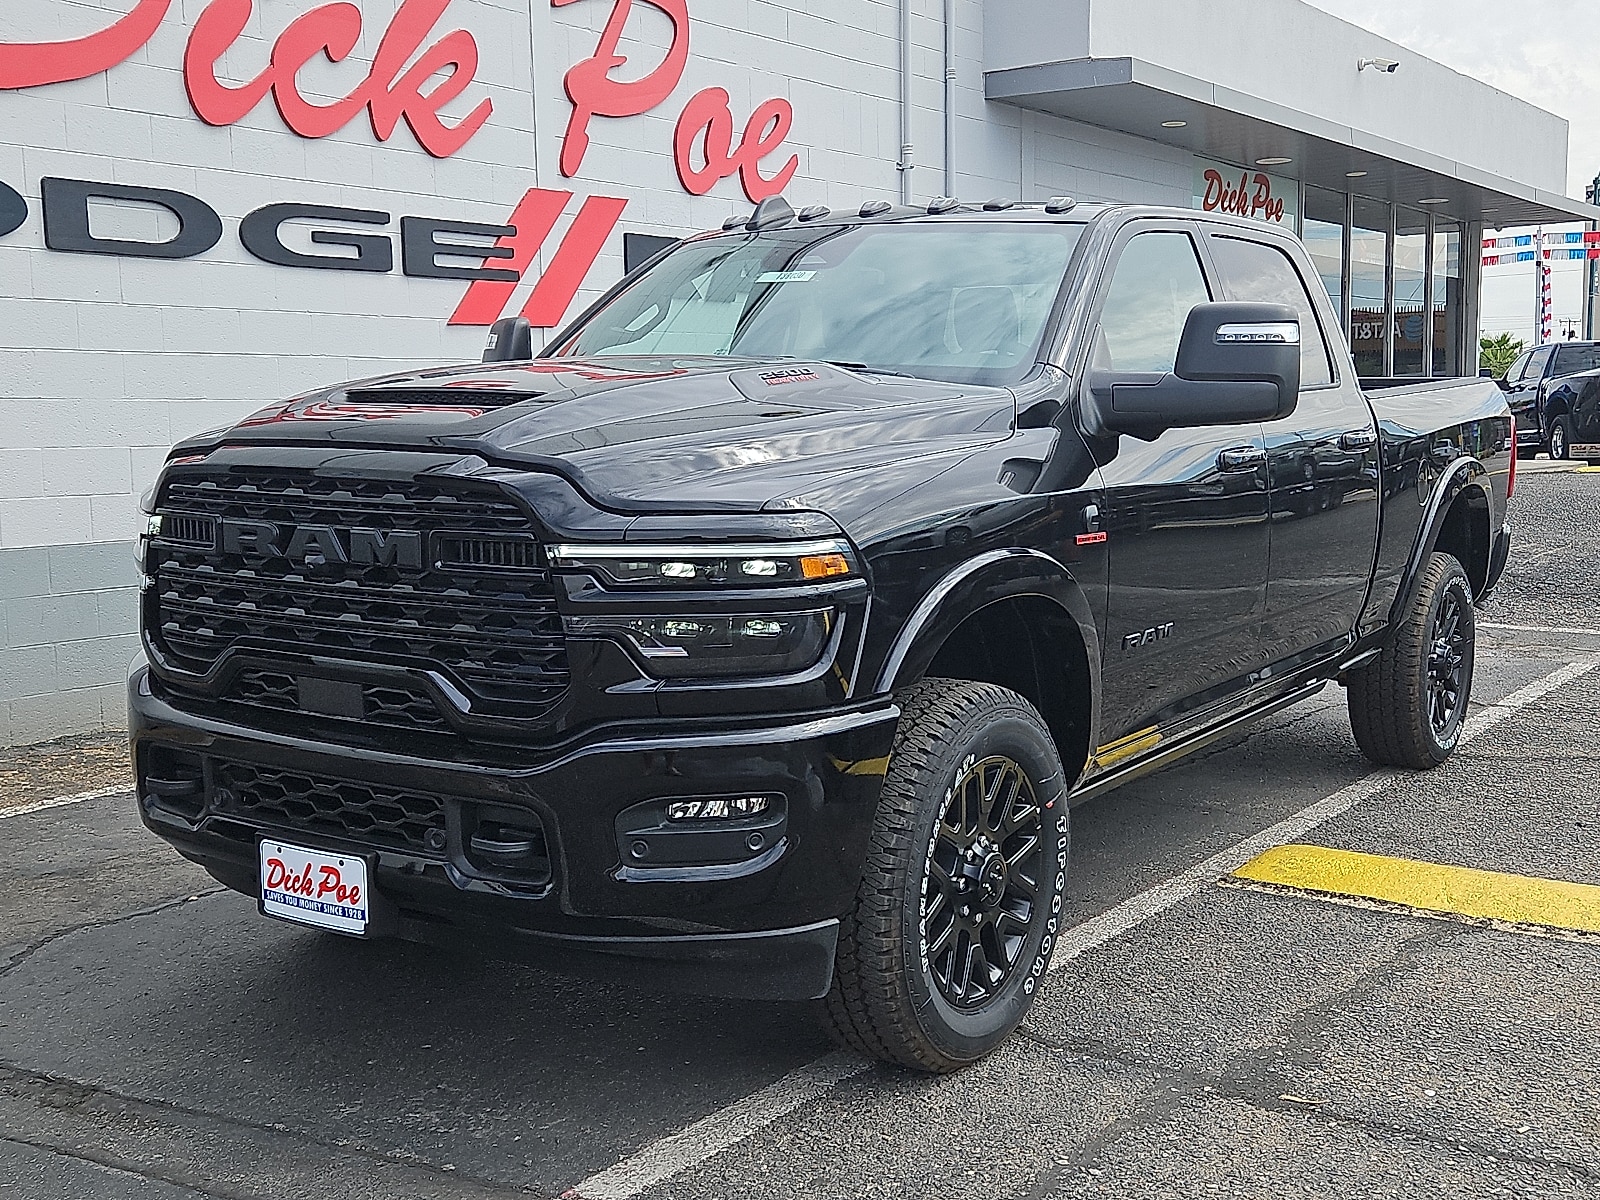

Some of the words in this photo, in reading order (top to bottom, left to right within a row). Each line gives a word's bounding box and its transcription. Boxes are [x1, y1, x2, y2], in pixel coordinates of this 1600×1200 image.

[551, 0, 799, 204] Poe
[1202, 169, 1249, 217] Dick
[1251, 173, 1284, 222] Poe
[222, 516, 422, 570] RAM
[266, 858, 315, 896] Dick
[317, 865, 362, 905] Poe
[266, 890, 284, 902] SAVES
[285, 895, 298, 906] YOU
[298, 898, 322, 911] MONEY
[323, 903, 343, 916] SINCE
[344, 907, 362, 919] 1928
